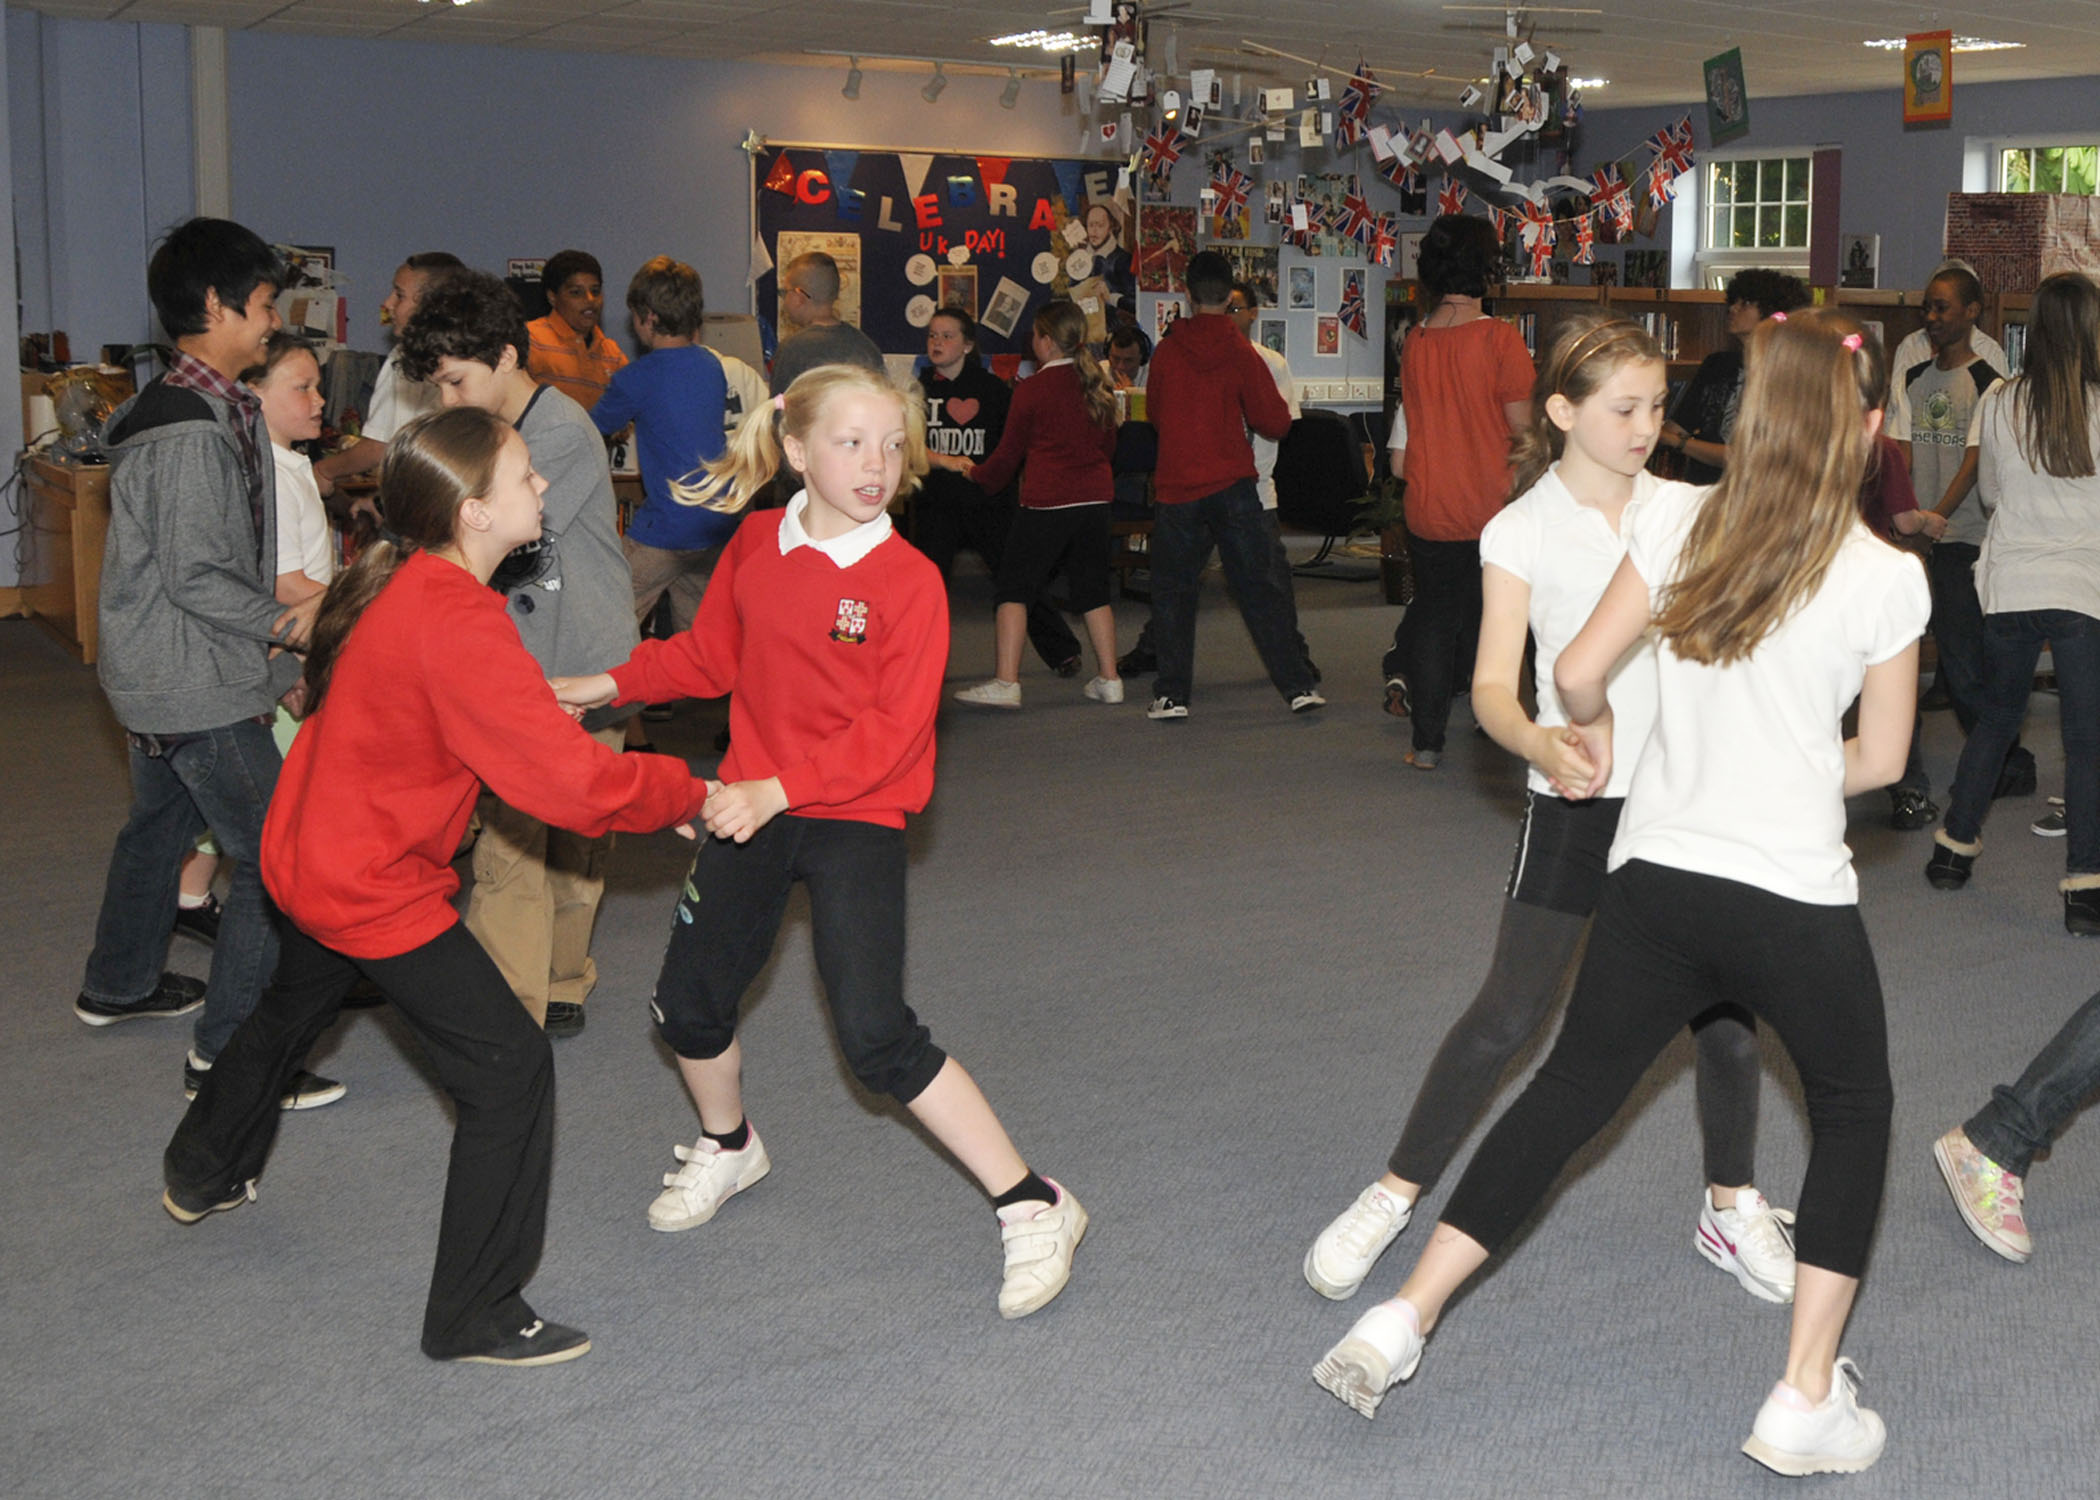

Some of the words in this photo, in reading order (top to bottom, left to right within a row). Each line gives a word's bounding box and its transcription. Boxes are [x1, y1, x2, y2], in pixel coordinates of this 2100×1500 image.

[965, 228, 1005, 258] DAY!
[928, 398, 943, 426] I
[928, 428, 985, 455] ONDON
